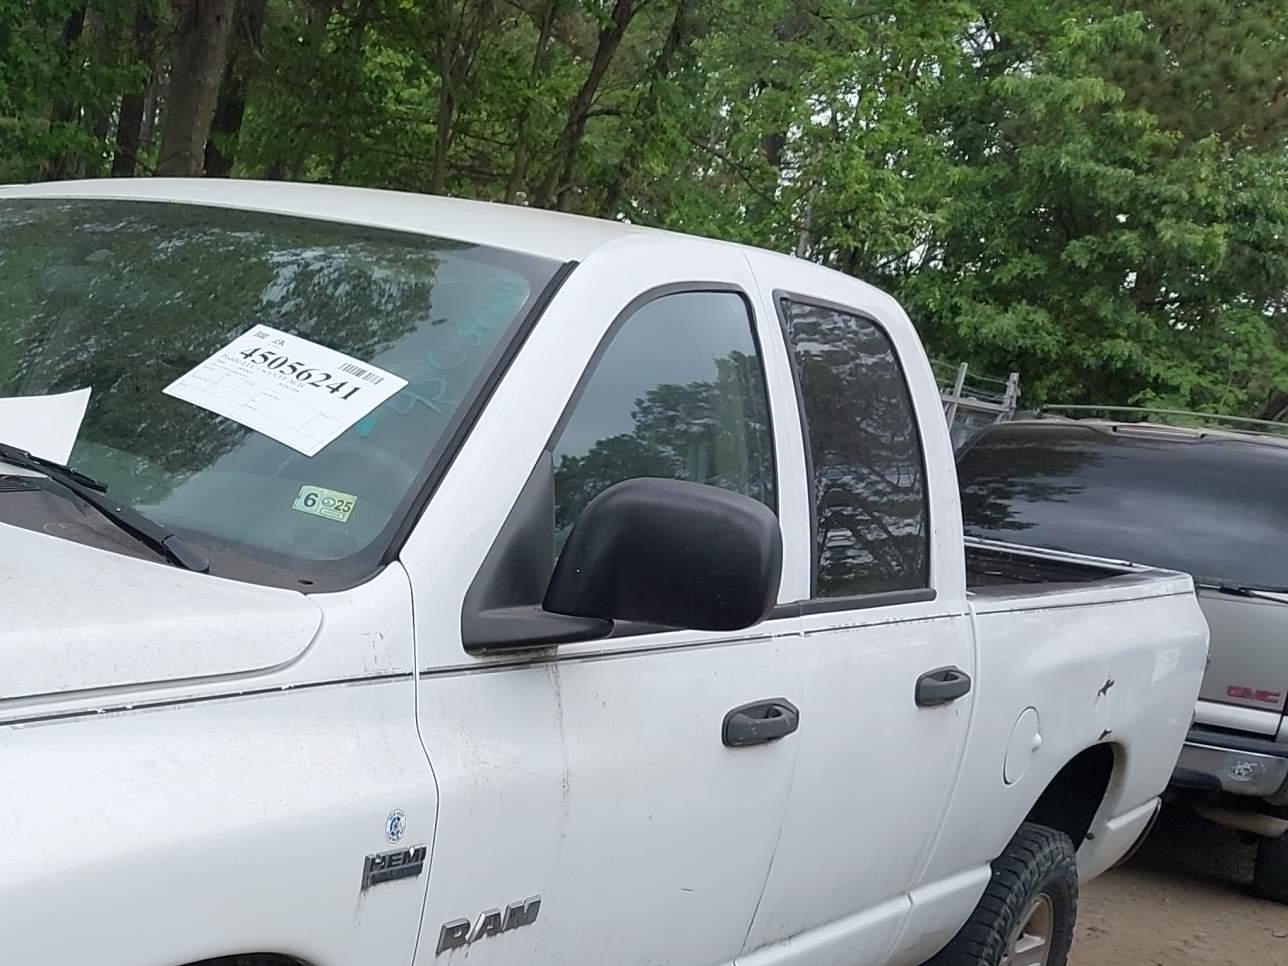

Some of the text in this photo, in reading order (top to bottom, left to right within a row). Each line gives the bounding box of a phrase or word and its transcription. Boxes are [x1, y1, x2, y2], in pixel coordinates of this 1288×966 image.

[239, 347, 363, 400] 45056241
[303, 492, 353, 513] 6 25
[365, 843, 428, 873] HEMI
[435, 894, 542, 957] RAM
